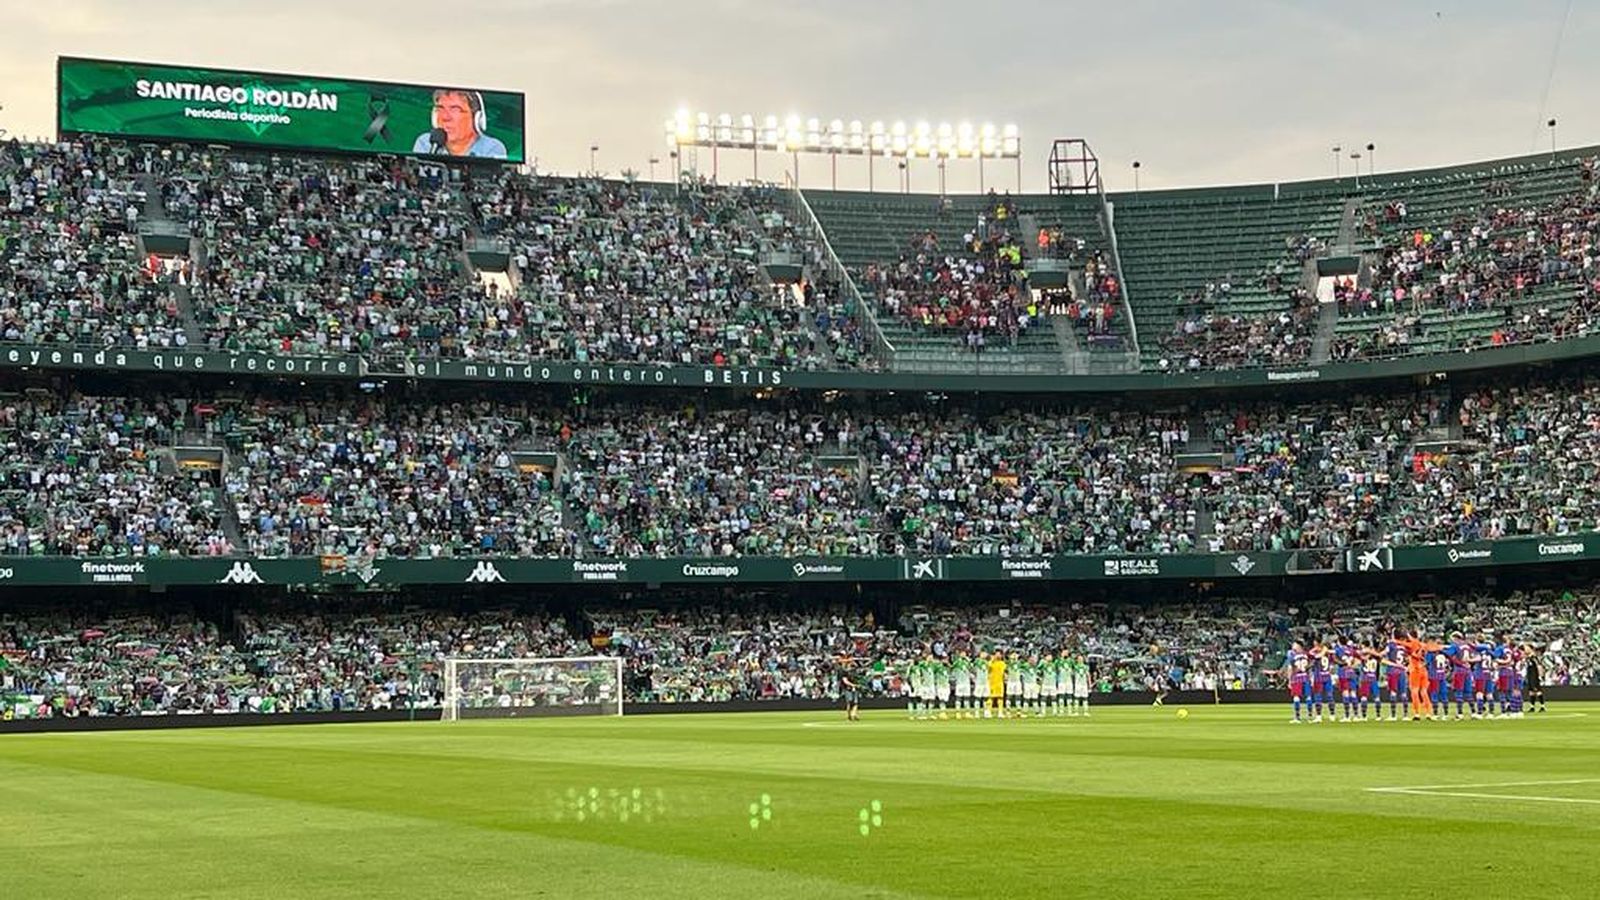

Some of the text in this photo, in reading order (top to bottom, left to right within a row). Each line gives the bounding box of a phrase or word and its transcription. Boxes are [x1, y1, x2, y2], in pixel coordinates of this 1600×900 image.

[136, 79, 338, 112] SANTIAGO ROLDÁN
[184, 106, 291, 125] Periodista deportivo
[154, 355, 204, 371] que
[230, 357, 347, 373] recorre
[417, 362, 440, 376] el
[465, 364, 552, 379] mundo
[573, 367, 677, 385] entero,
[704, 370, 782, 386] BETIS
[1538, 543, 1584, 555] Cruzcampo
[81, 561, 145, 573] finetwork
[573, 561, 627, 572] finetwork
[1002, 559, 1051, 570] finetwork
[1120, 559, 1158, 568] REALE
[682, 563, 739, 577] Cruzcampo
